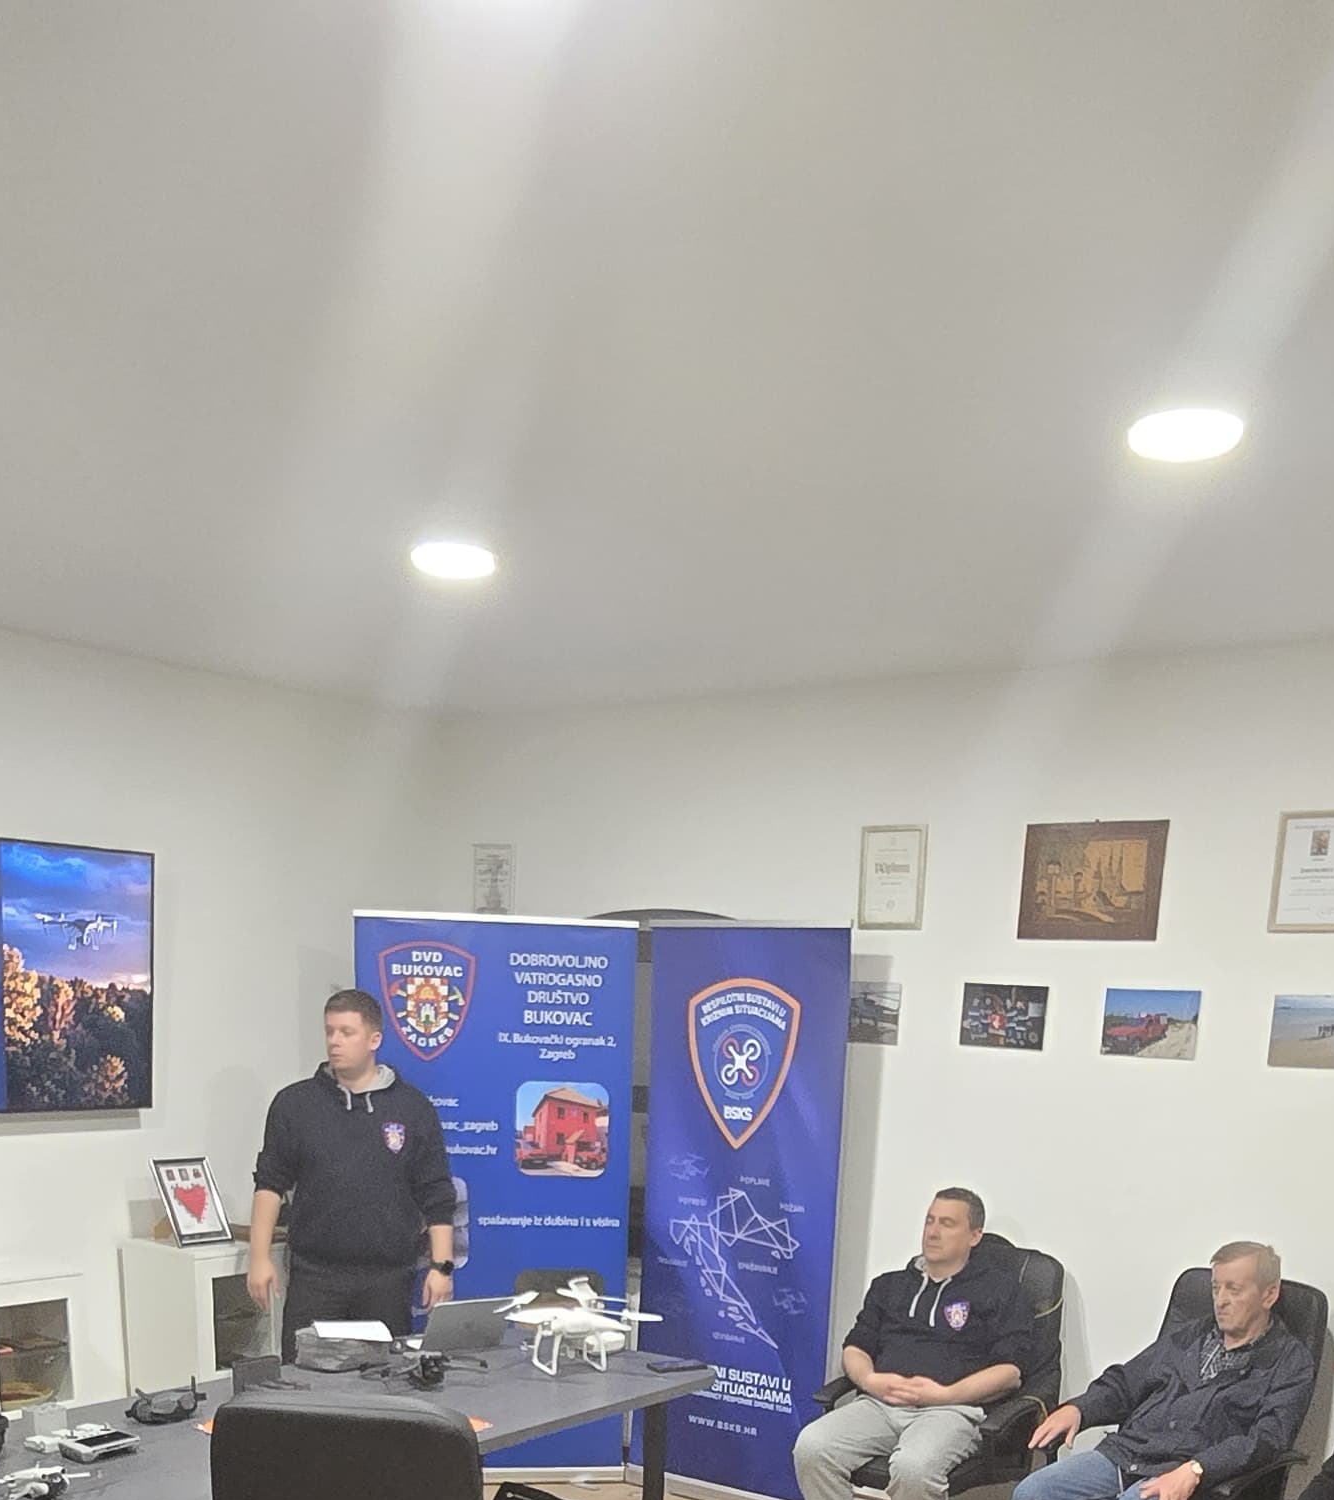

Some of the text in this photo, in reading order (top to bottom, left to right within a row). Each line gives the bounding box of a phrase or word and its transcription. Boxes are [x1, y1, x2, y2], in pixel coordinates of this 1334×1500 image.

[411, 951, 443, 962] DVD
[509, 953, 608, 969] DOBROVOLJNO
[391, 964, 463, 977] BUKOVAC
[514, 972, 602, 987] VATROGASNO
[527, 990, 589, 1005] DRUŠTVO
[523, 1010, 593, 1026] BUKOVAC
[401, 1025, 454, 1047] ZAGREB
[539, 1048, 576, 1061] Zagreb
[723, 1105, 753, 1121] BSKS
[728, 1368, 779, 1390] SUSTAVI
[782, 1378, 792, 1391] U
[711, 1379, 792, 1406] SITUACIJAMA
